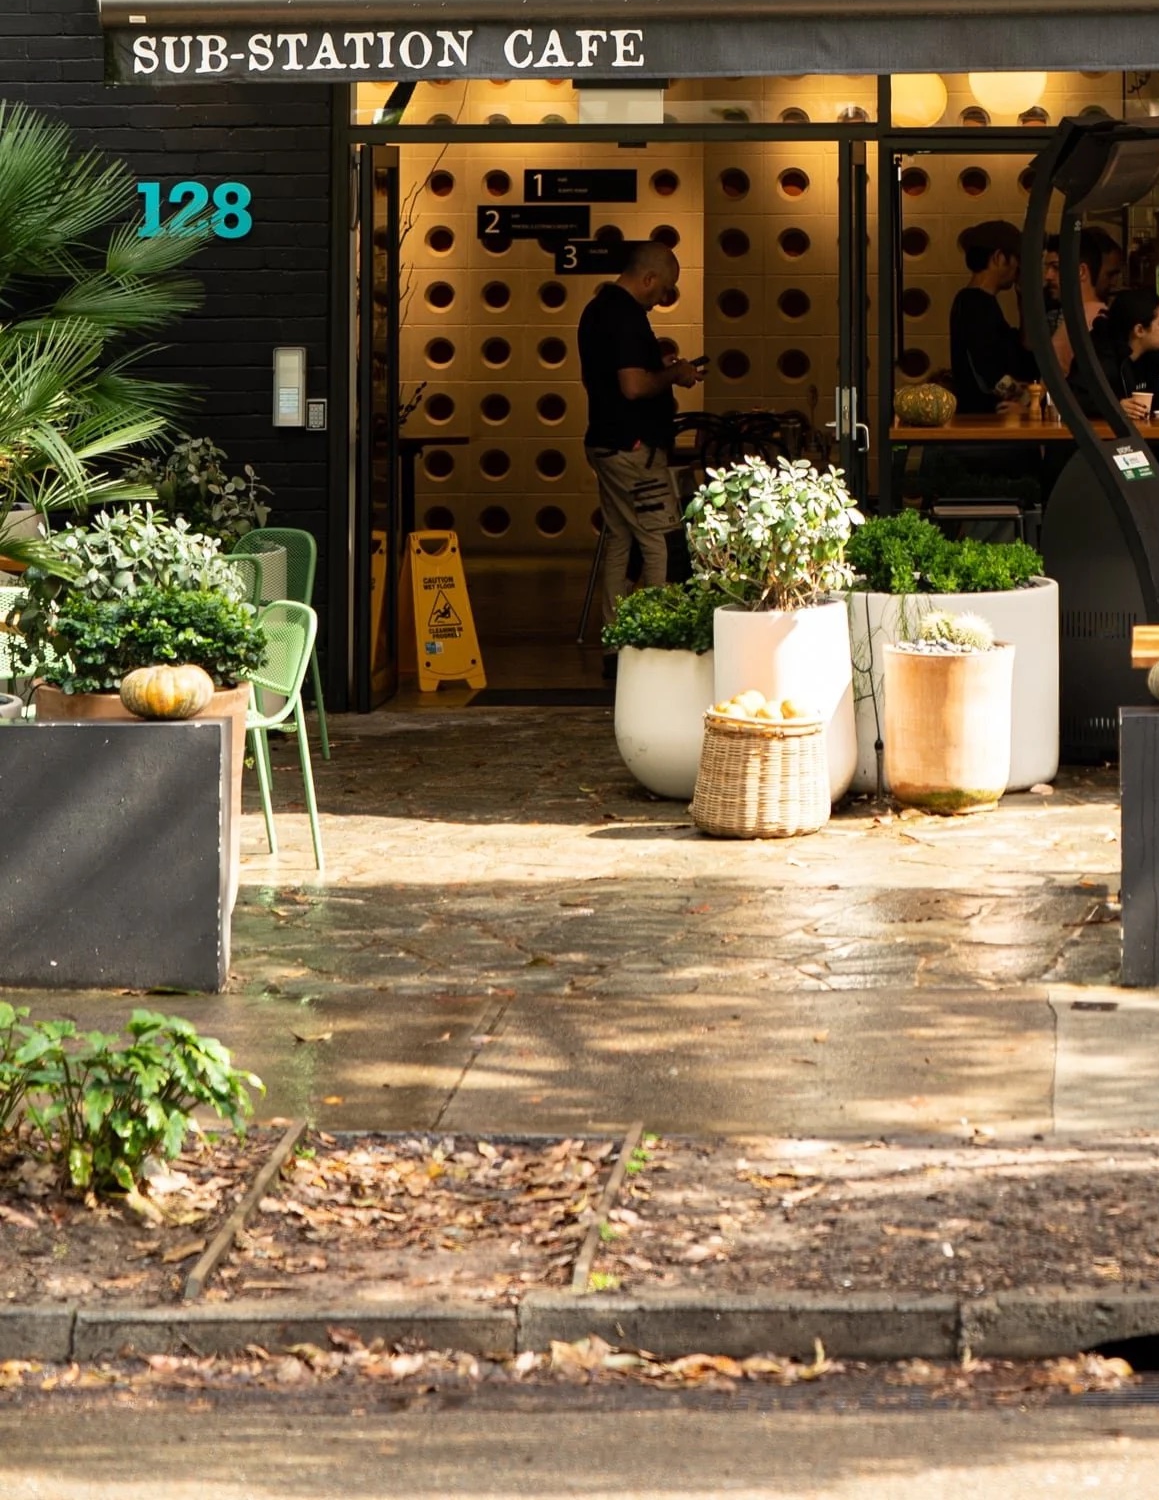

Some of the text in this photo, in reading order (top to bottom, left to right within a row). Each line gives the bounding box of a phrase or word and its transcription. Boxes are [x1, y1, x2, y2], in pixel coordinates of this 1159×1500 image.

[132, 29, 645, 74] SUB-STATION CAFE
[533, 173, 542, 197] 1
[137, 181, 252, 239] 128
[484, 210, 500, 234] 2
[563, 245, 578, 269] 3
